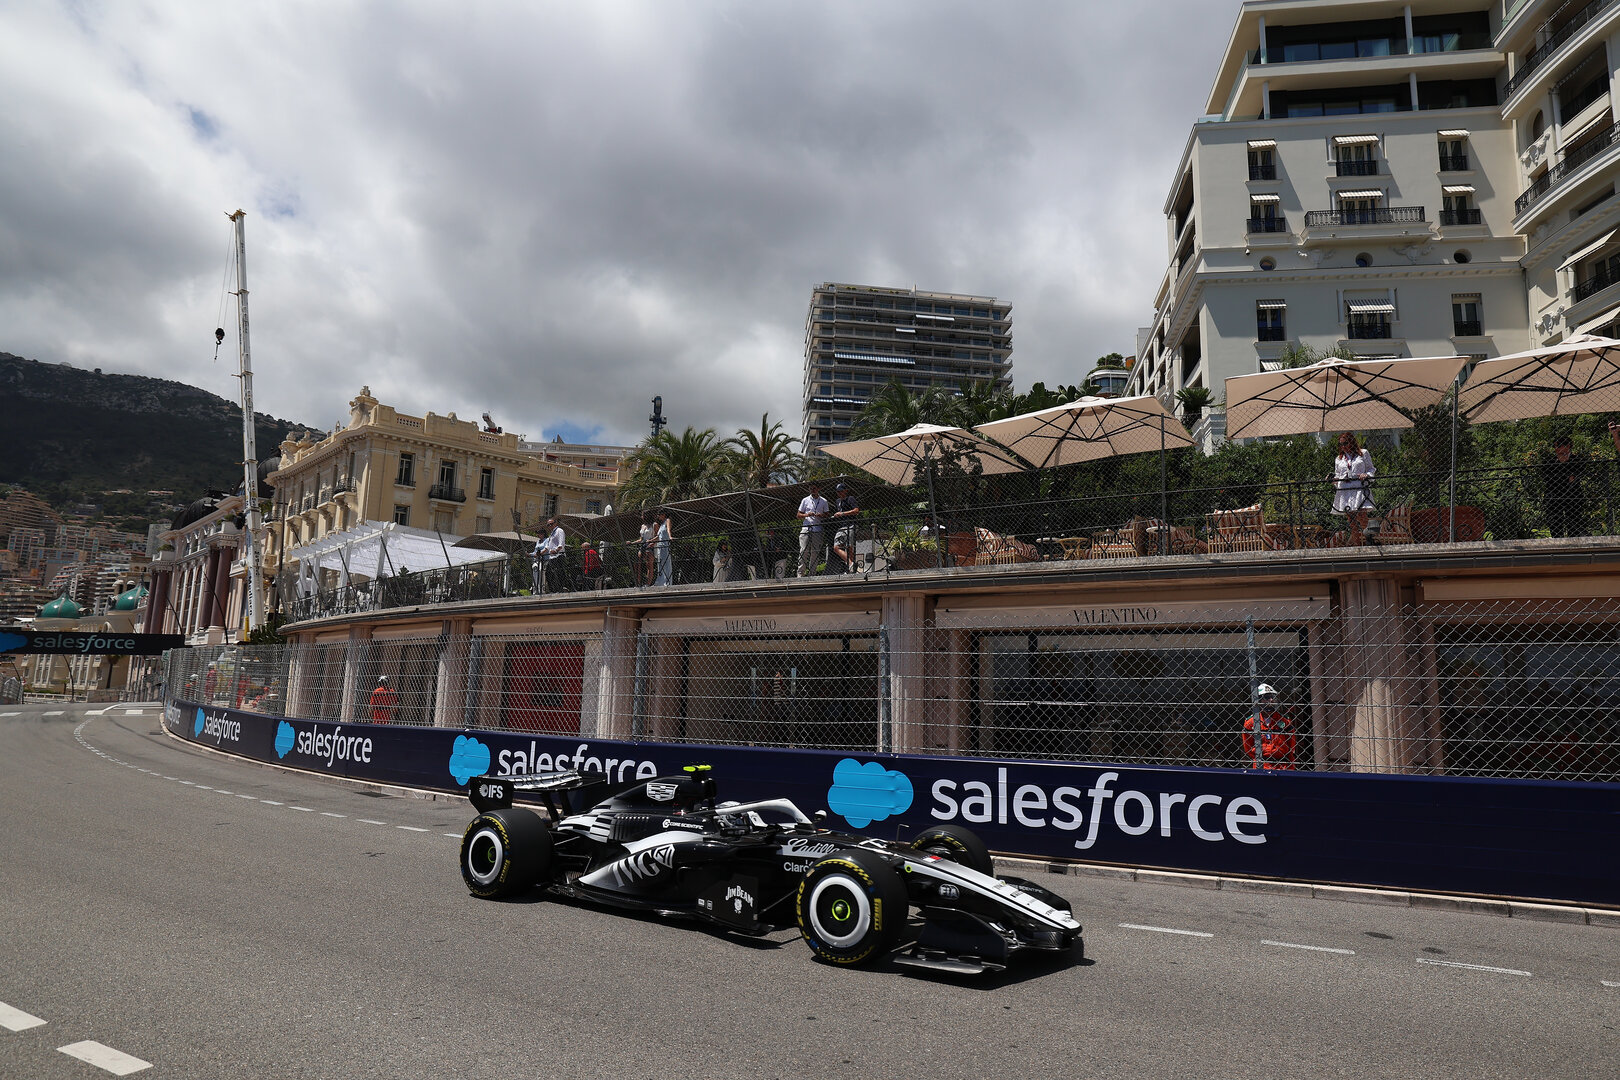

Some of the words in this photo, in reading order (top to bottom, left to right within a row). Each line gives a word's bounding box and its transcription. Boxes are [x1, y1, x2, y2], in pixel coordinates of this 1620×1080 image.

[1073, 607, 1157, 623] VALENTINO
[725, 619, 777, 631] VALENTINO
[33, 634, 136, 652] salesforce
[204, 711, 241, 744] salesforce
[297, 724, 373, 768] salesforce
[488, 785, 504, 799] IFS
[930, 767, 1268, 849] salesforce
[788, 838, 840, 854] Cadill
[940, 886, 957, 898] FIA
